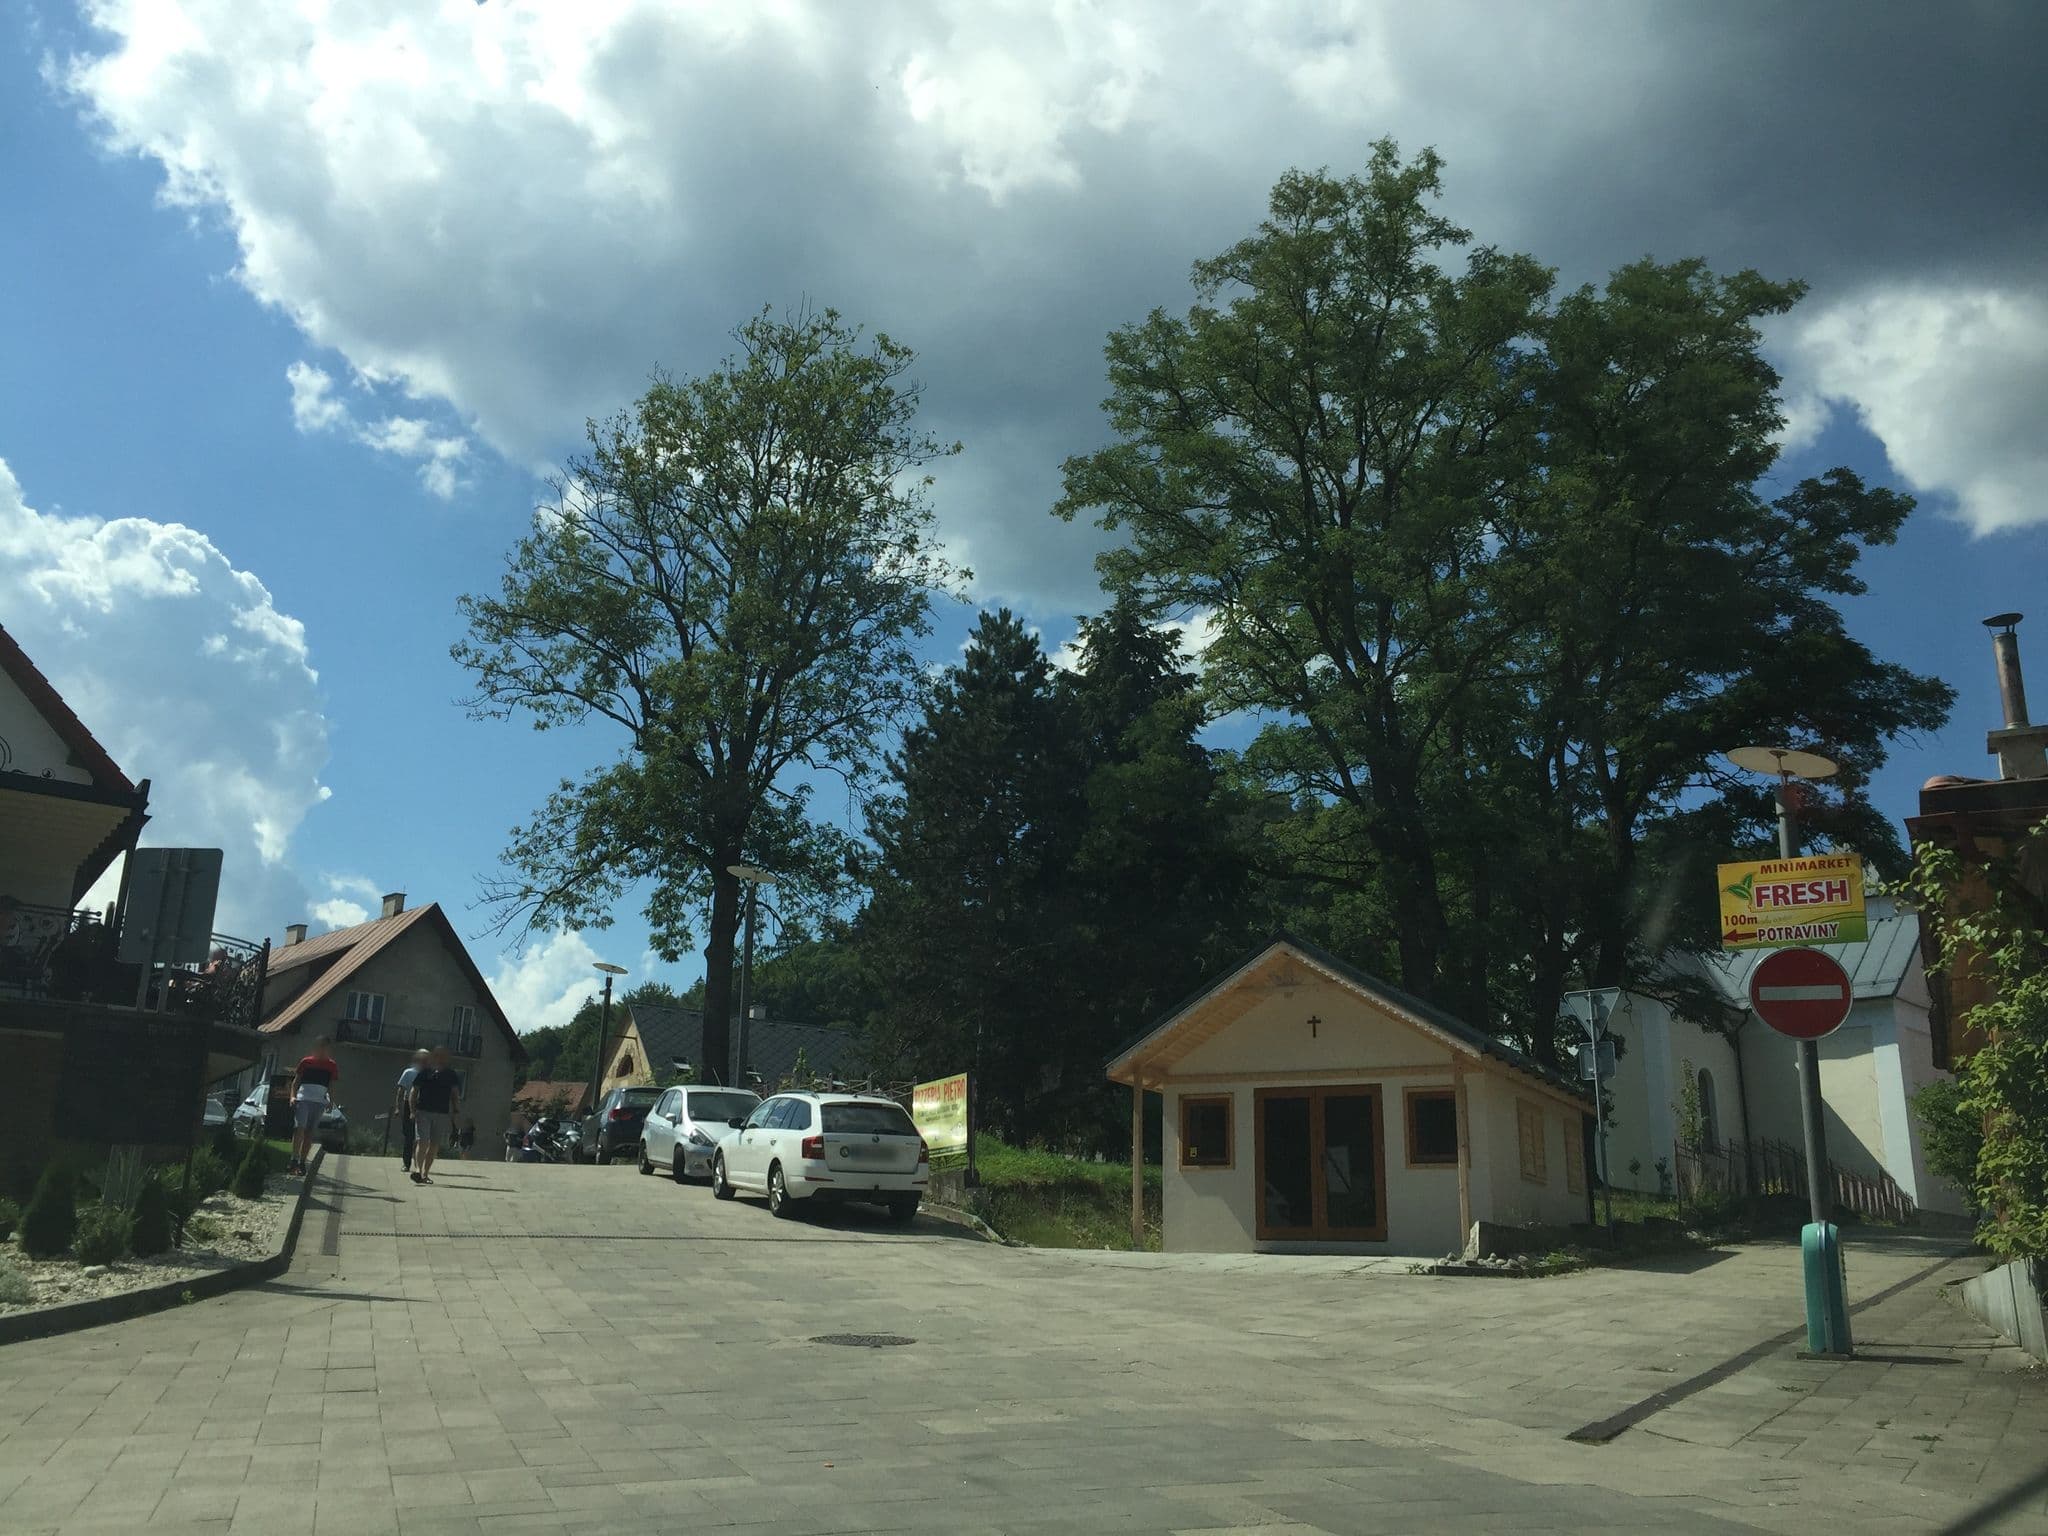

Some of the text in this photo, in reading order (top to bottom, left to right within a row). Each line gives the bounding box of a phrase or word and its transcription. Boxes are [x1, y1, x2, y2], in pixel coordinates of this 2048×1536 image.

[1760, 858, 1851, 875] MINIMARKET
[1755, 879, 1849, 908] FRESH
[1723, 914, 1758, 926] 100m
[1757, 923, 1839, 942] POTRAVINY
